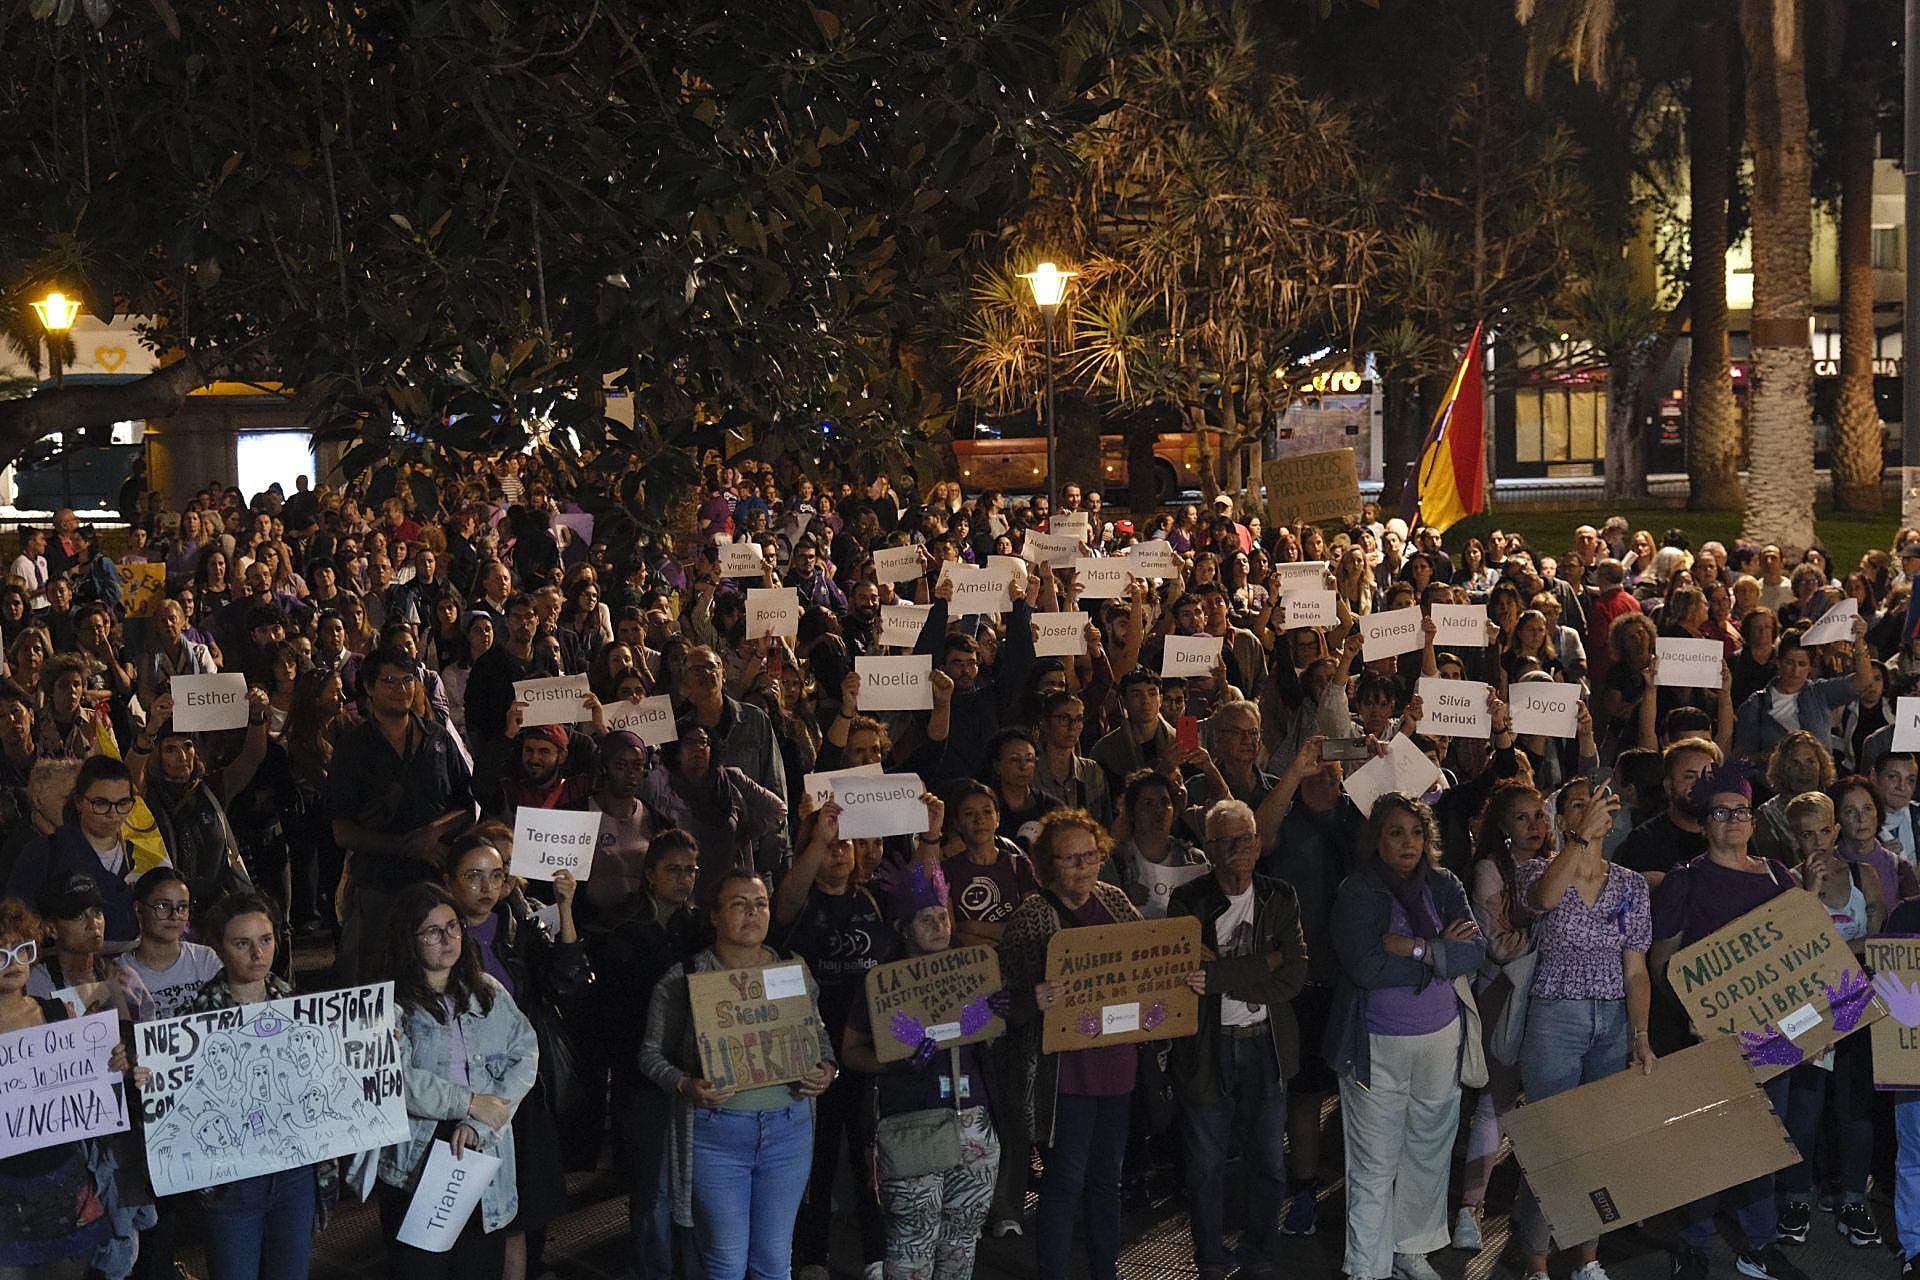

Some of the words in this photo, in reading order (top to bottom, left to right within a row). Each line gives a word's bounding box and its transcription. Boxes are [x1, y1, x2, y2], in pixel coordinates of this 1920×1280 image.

[727, 563, 756, 572] Virginia
[880, 556, 914, 569] Maritza
[1140, 561, 1168, 569] Carmen
[1087, 570, 1121, 580] Marta
[956, 580, 1003, 593] Amelia
[1442, 616, 1478, 628] Nadia
[1042, 625, 1079, 637] Josefa
[1369, 621, 1416, 640] Ginesa
[1175, 651, 1212, 663] Diana
[1660, 650, 1719, 664] Jacqueline
[868, 671, 919, 686] Noelia
[187, 690, 237, 706] Esther
[523, 686, 583, 702] Cristina
[1438, 694, 1471, 708] Silvia
[1525, 696, 1566, 714] Joyco
[607, 709, 667, 730] Yolanda
[1431, 711, 1476, 725] Mariuxi
[844, 787, 916, 805] Consuelo
[526, 828, 576, 844] Teresa
[578, 832, 592, 845] de
[539, 851, 579, 867] Jesús
[876, 968, 902, 995] LA
[908, 948, 990, 982] VIOLENCIA
[1700, 962, 1780, 1019] SORDAS
[1779, 932, 1832, 973] VIVAS
[143, 1005, 244, 1063] NUESTRA
[293, 986, 386, 1039] HISTORIA
[45, 1030, 76, 1054] QUE
[30, 1058, 95, 1088] JUSTICIA
[167, 1064, 195, 1092] SE
[361, 1068, 403, 1107] MIEDO
[142, 1092, 176, 1124] CON
[426, 1168, 467, 1230] Triana
